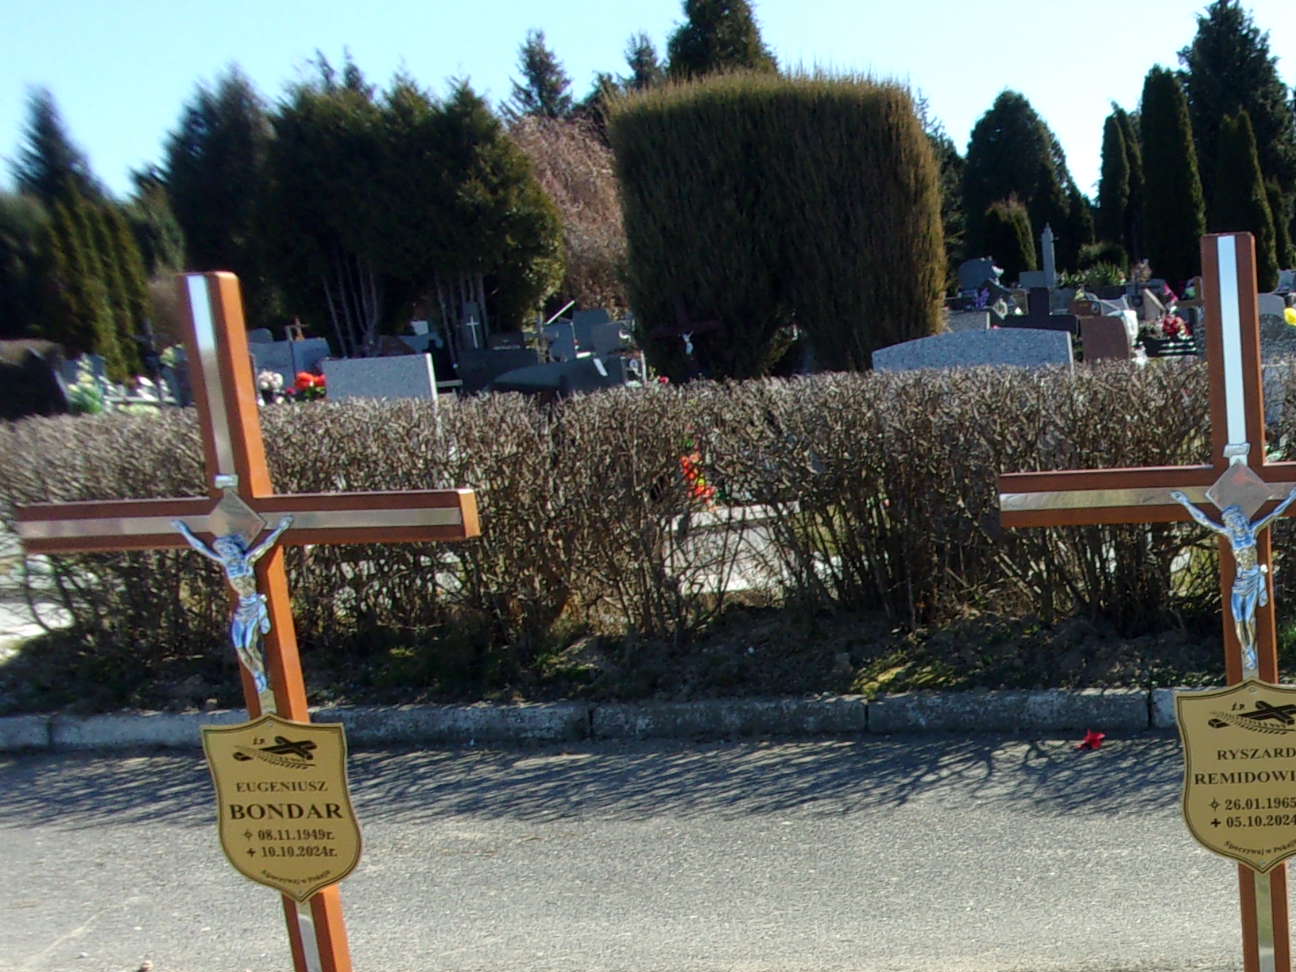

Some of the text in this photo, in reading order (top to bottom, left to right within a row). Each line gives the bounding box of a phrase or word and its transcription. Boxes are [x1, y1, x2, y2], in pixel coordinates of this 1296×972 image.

[1217, 747, 1296, 761] RYSZARD
[236, 780, 329, 793] EUGENIUSZ
[230, 803, 343, 820] BONDAR
